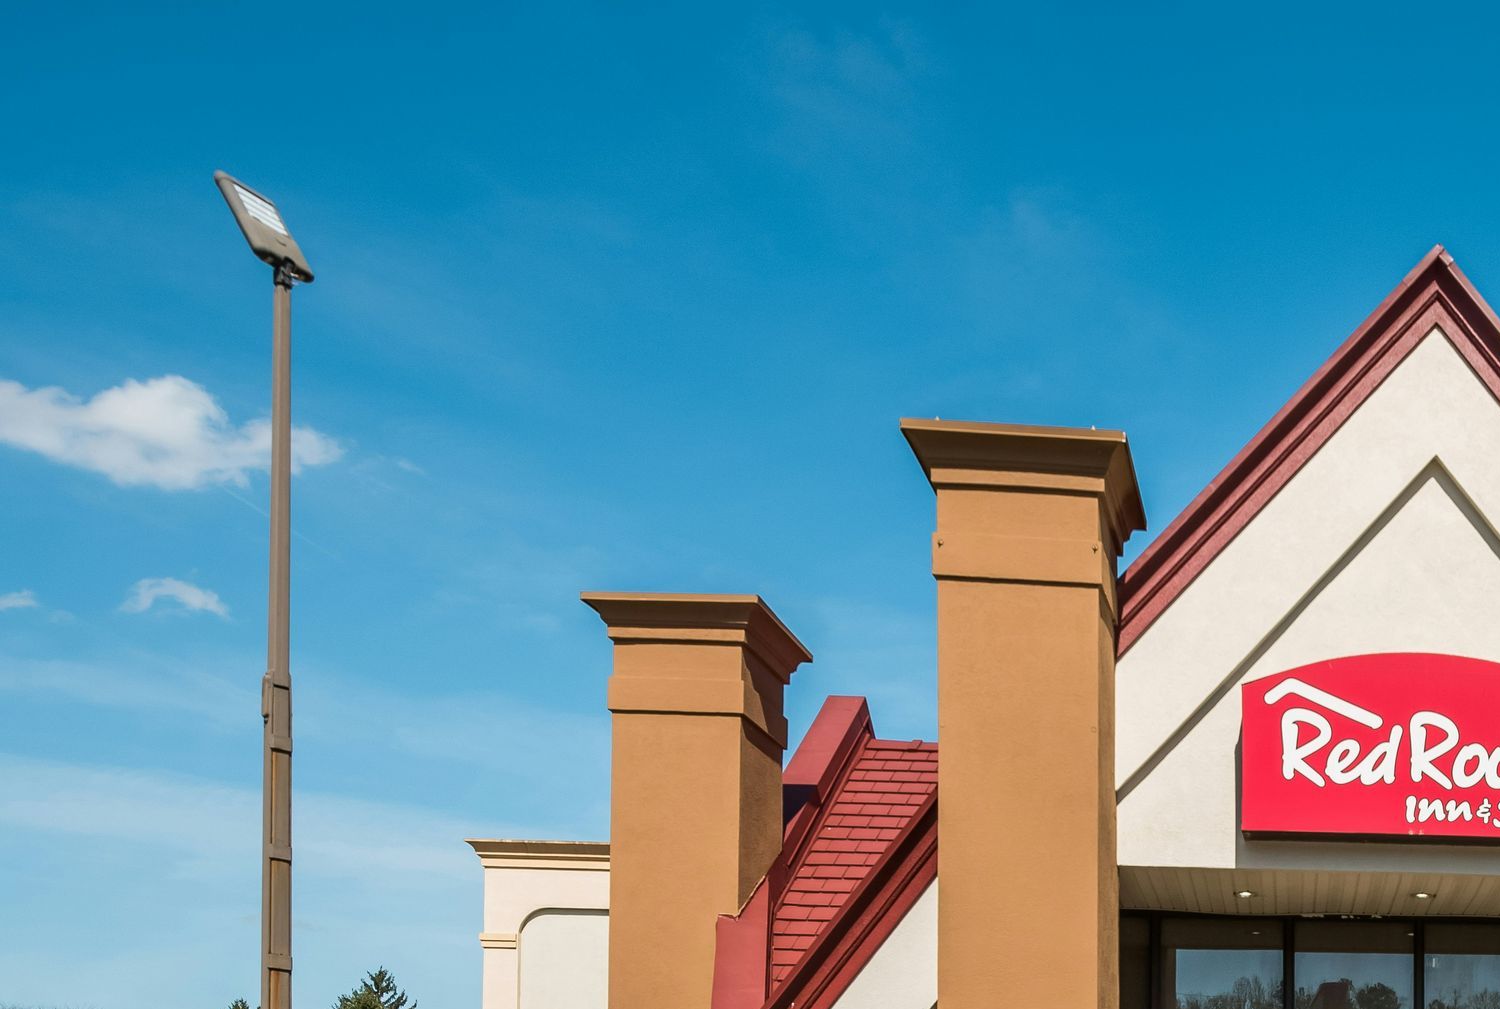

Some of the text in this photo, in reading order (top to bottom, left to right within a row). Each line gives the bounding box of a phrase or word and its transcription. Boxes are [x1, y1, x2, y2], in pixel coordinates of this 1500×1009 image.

[1281, 707, 1403, 787] Red
[1405, 795, 1473, 824] Inn
[1476, 798, 1492, 824] &
